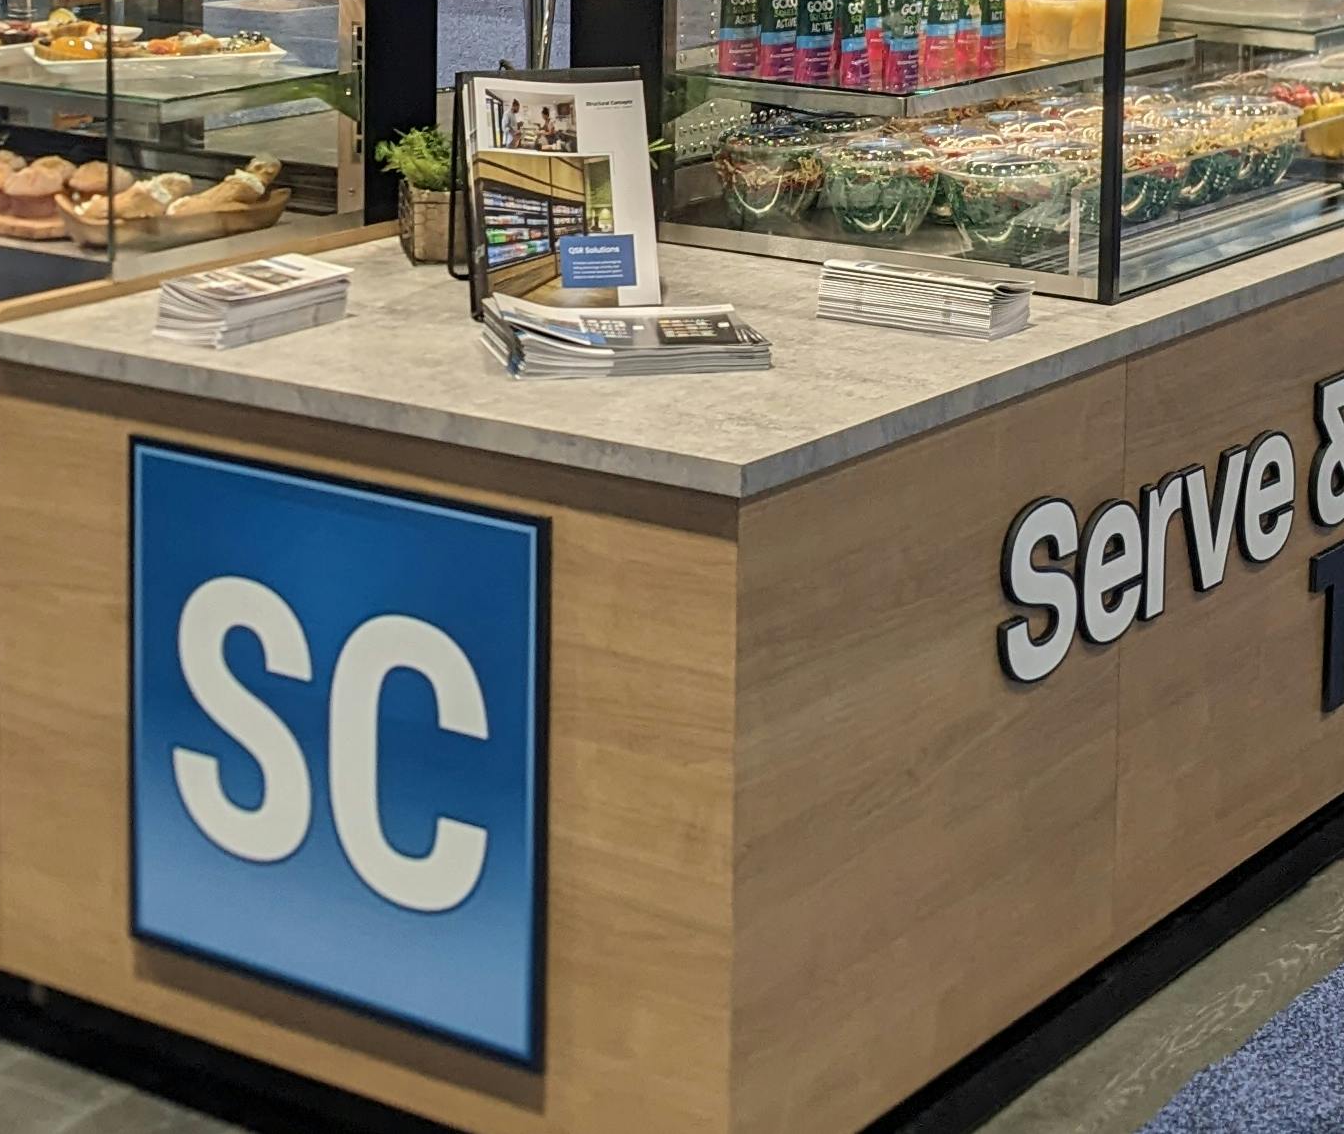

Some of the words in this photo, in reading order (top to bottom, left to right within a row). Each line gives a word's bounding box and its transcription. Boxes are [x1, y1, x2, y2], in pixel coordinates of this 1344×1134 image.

[584, 246, 620, 254] Solutions
[996, 429, 1297, 683] Serve
[171, 573, 491, 915] SC
